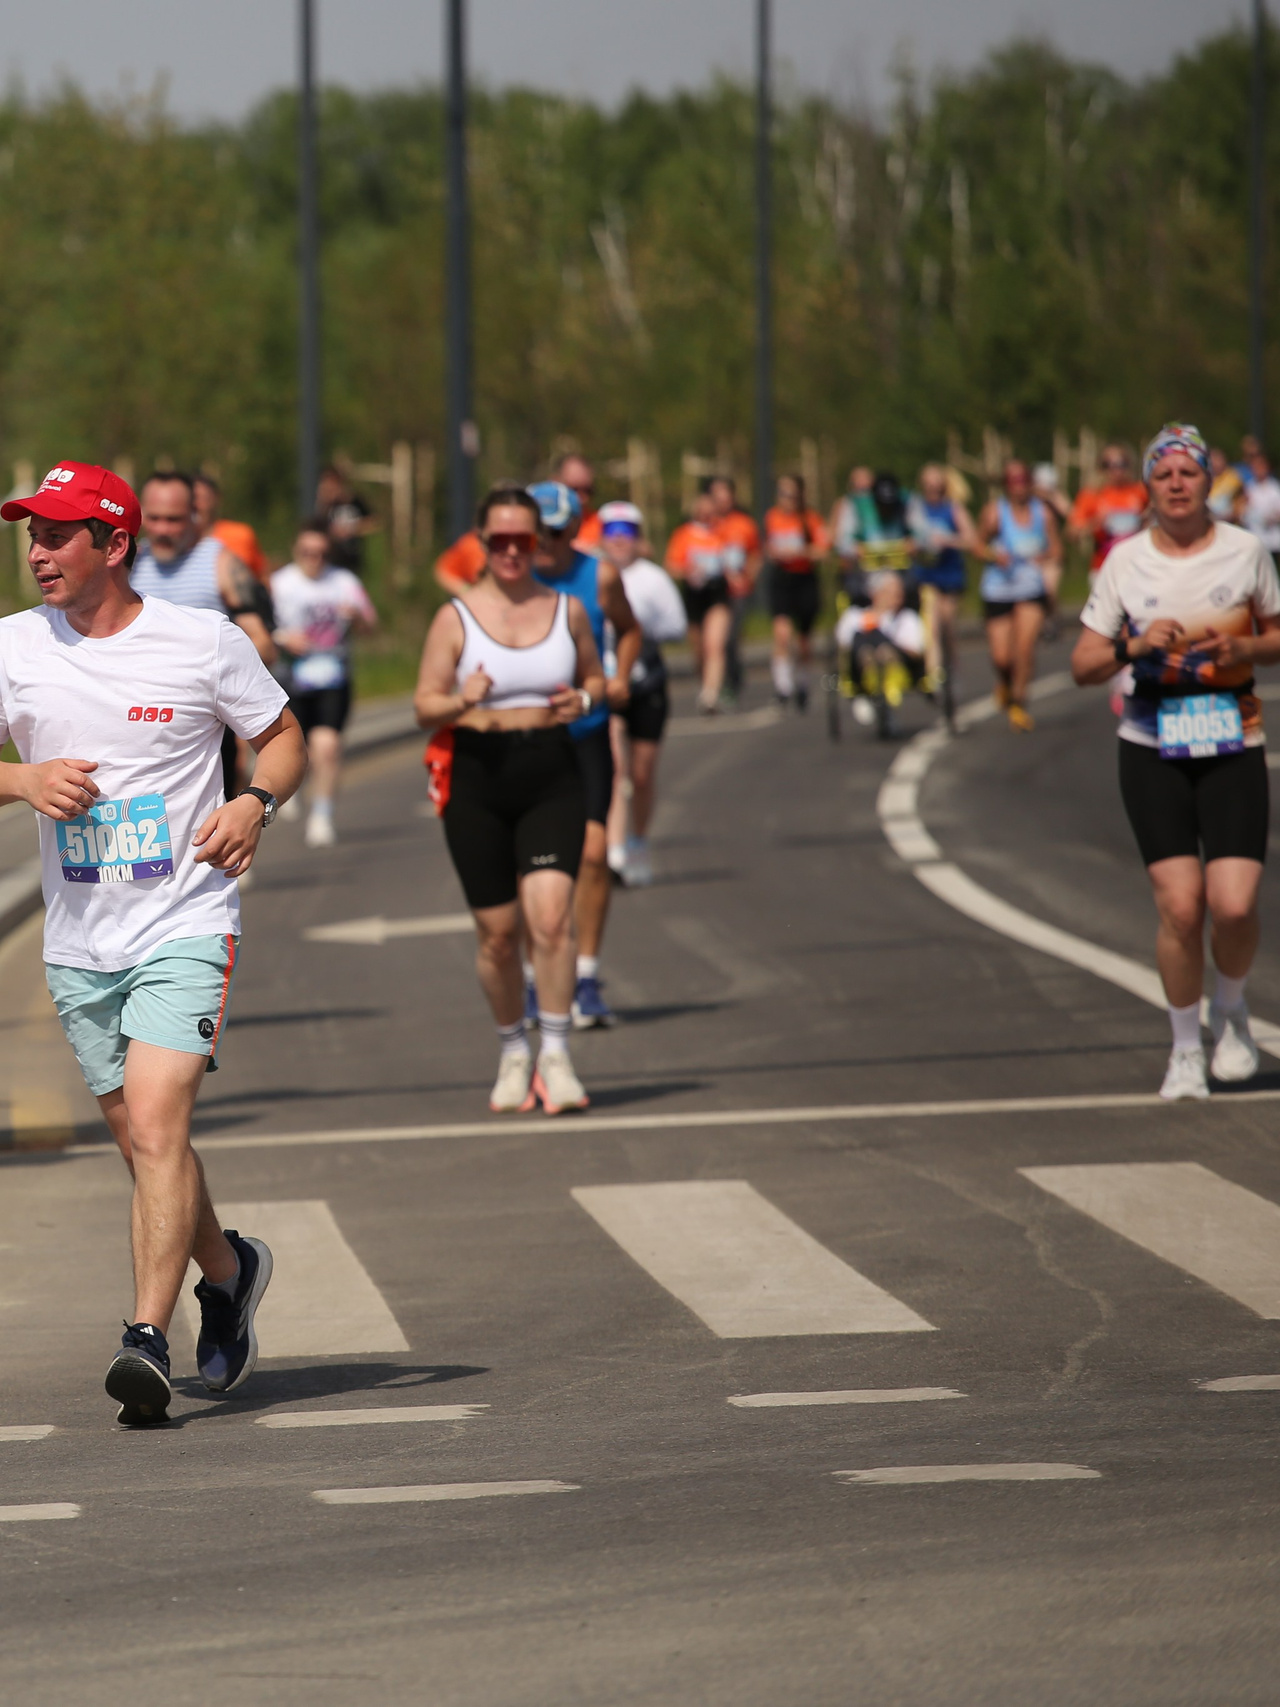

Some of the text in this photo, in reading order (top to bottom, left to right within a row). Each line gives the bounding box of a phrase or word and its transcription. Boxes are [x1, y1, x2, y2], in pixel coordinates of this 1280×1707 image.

[128, 707, 173, 722] ЛСР
[1162, 709, 1239, 746] 50053
[97, 803, 118, 822] 10
[65, 818, 161, 864] 51062
[97, 864, 135, 883] 10KM
